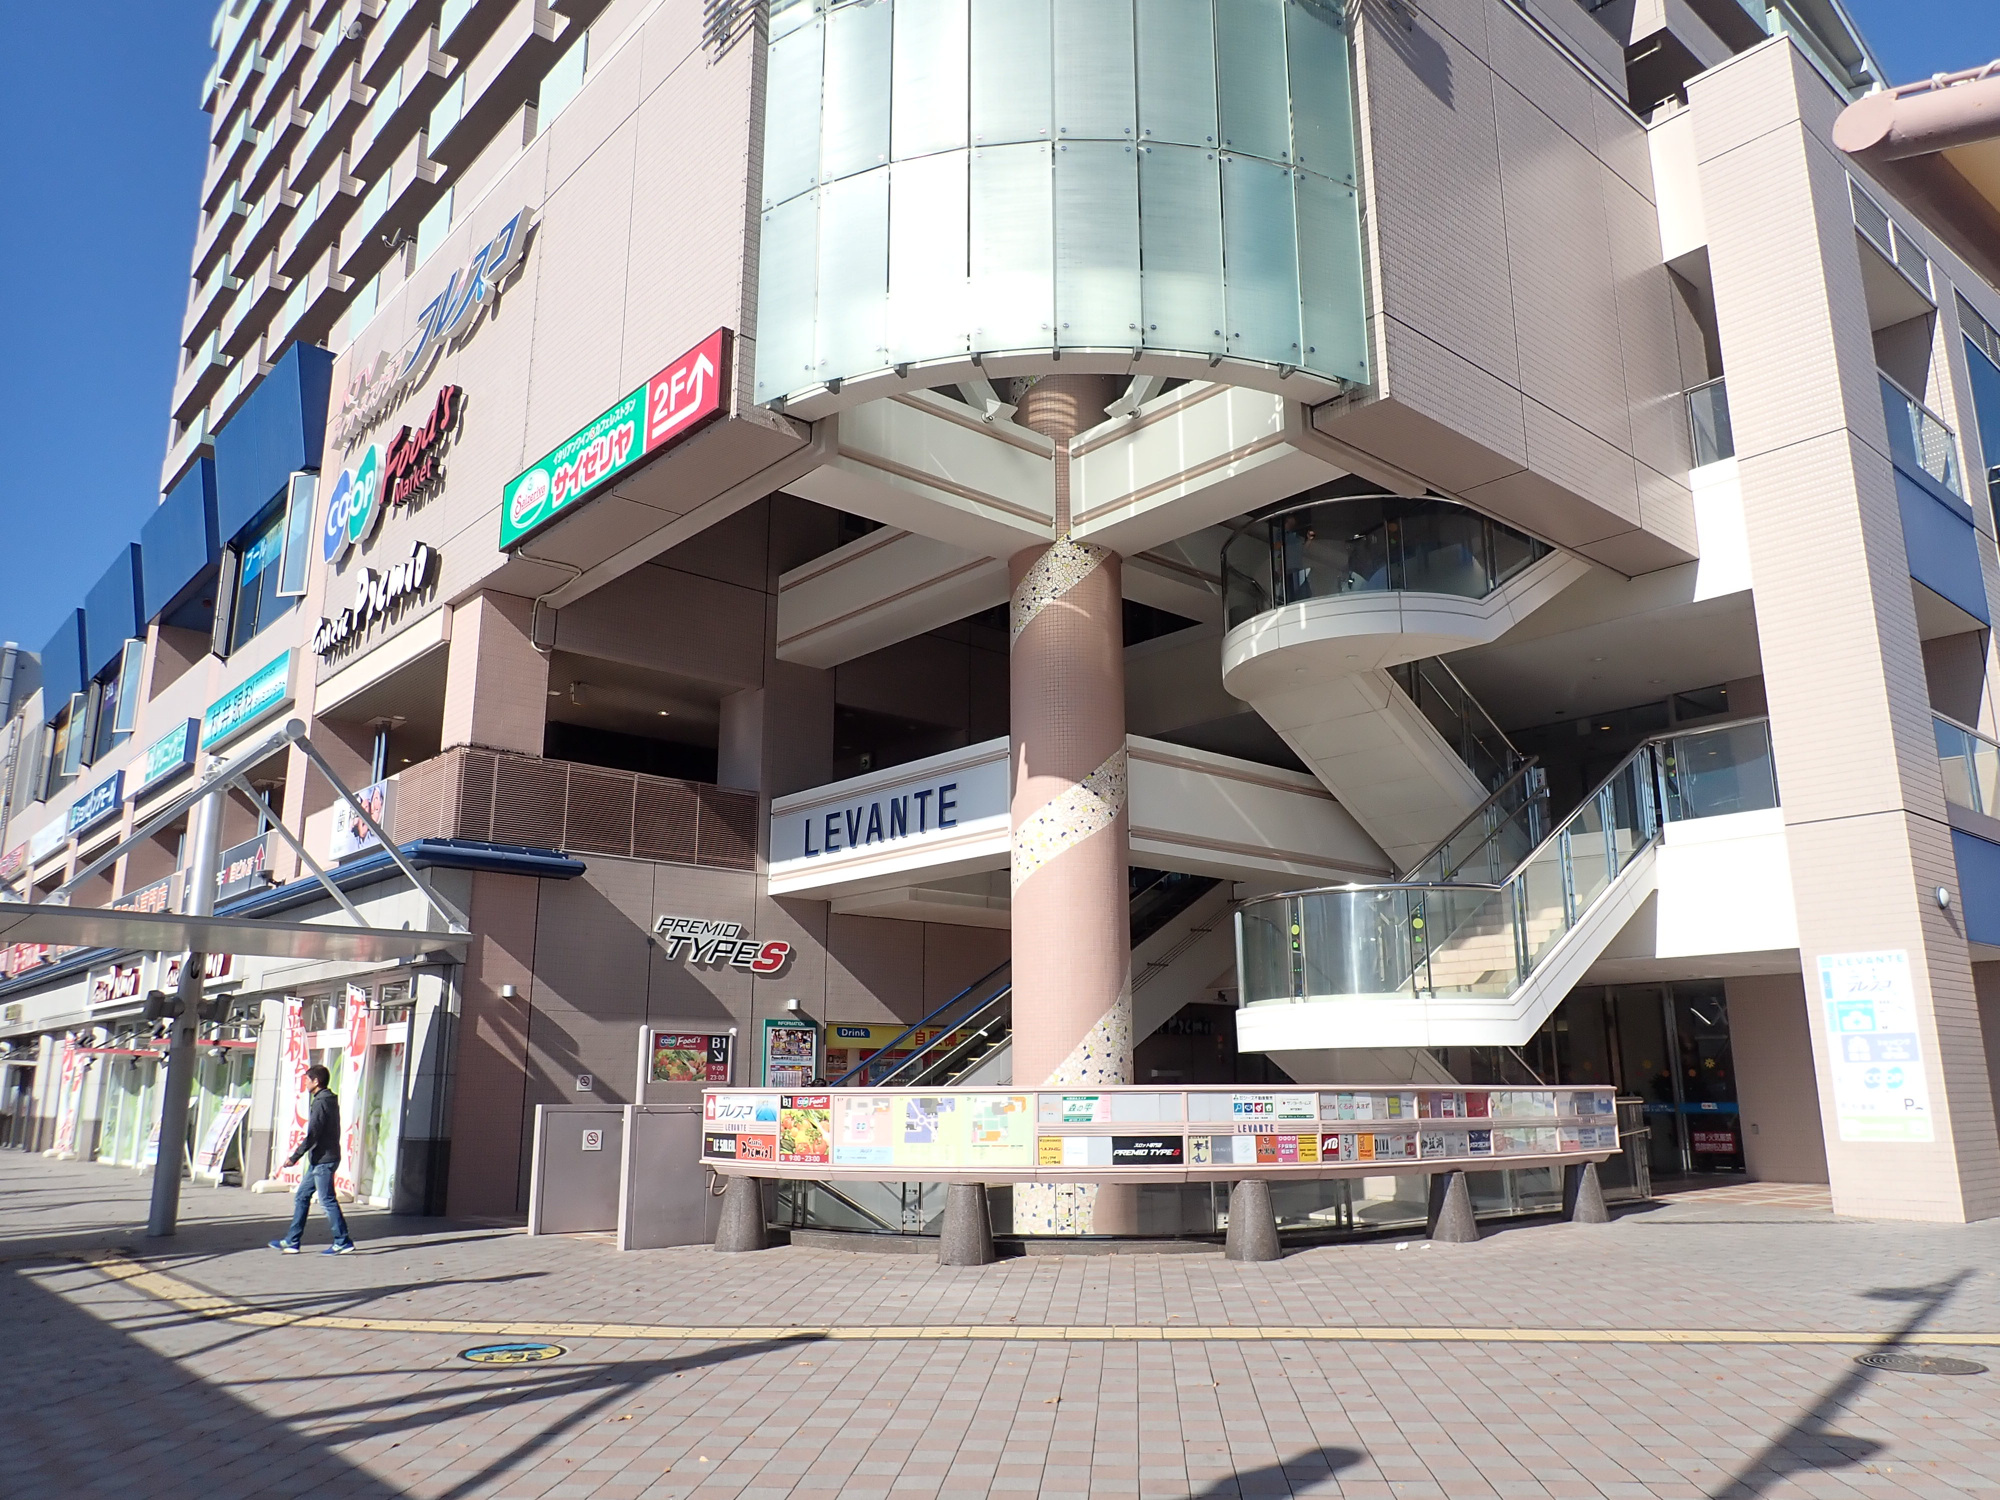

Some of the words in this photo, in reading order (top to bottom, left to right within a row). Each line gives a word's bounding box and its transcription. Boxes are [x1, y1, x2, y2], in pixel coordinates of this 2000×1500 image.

[400, 207, 526, 379] フレスコ
[653, 366, 688, 424] 2F
[379, 384, 456, 504] Food's
[551, 420, 635, 509] サイゼリヤ
[392, 457, 433, 506] Market
[512, 483, 546, 520] Saizeriya
[210, 682, 255, 739] 村井眼科
[803, 783, 958, 858] LEVANTE
[655, 916, 741, 938] PREMIO
[1838, 954, 1905, 966] LEVANTE
[712, 1037, 726, 1049] B1
[841, 1028, 866, 1037] Drink
[717, 1104, 754, 1119] フレスコ
[1237, 1124, 1275, 1133] LEVANTE
[1322, 1137, 1338, 1151] JTB
[1375, 1139, 1389, 1151] DIVA
